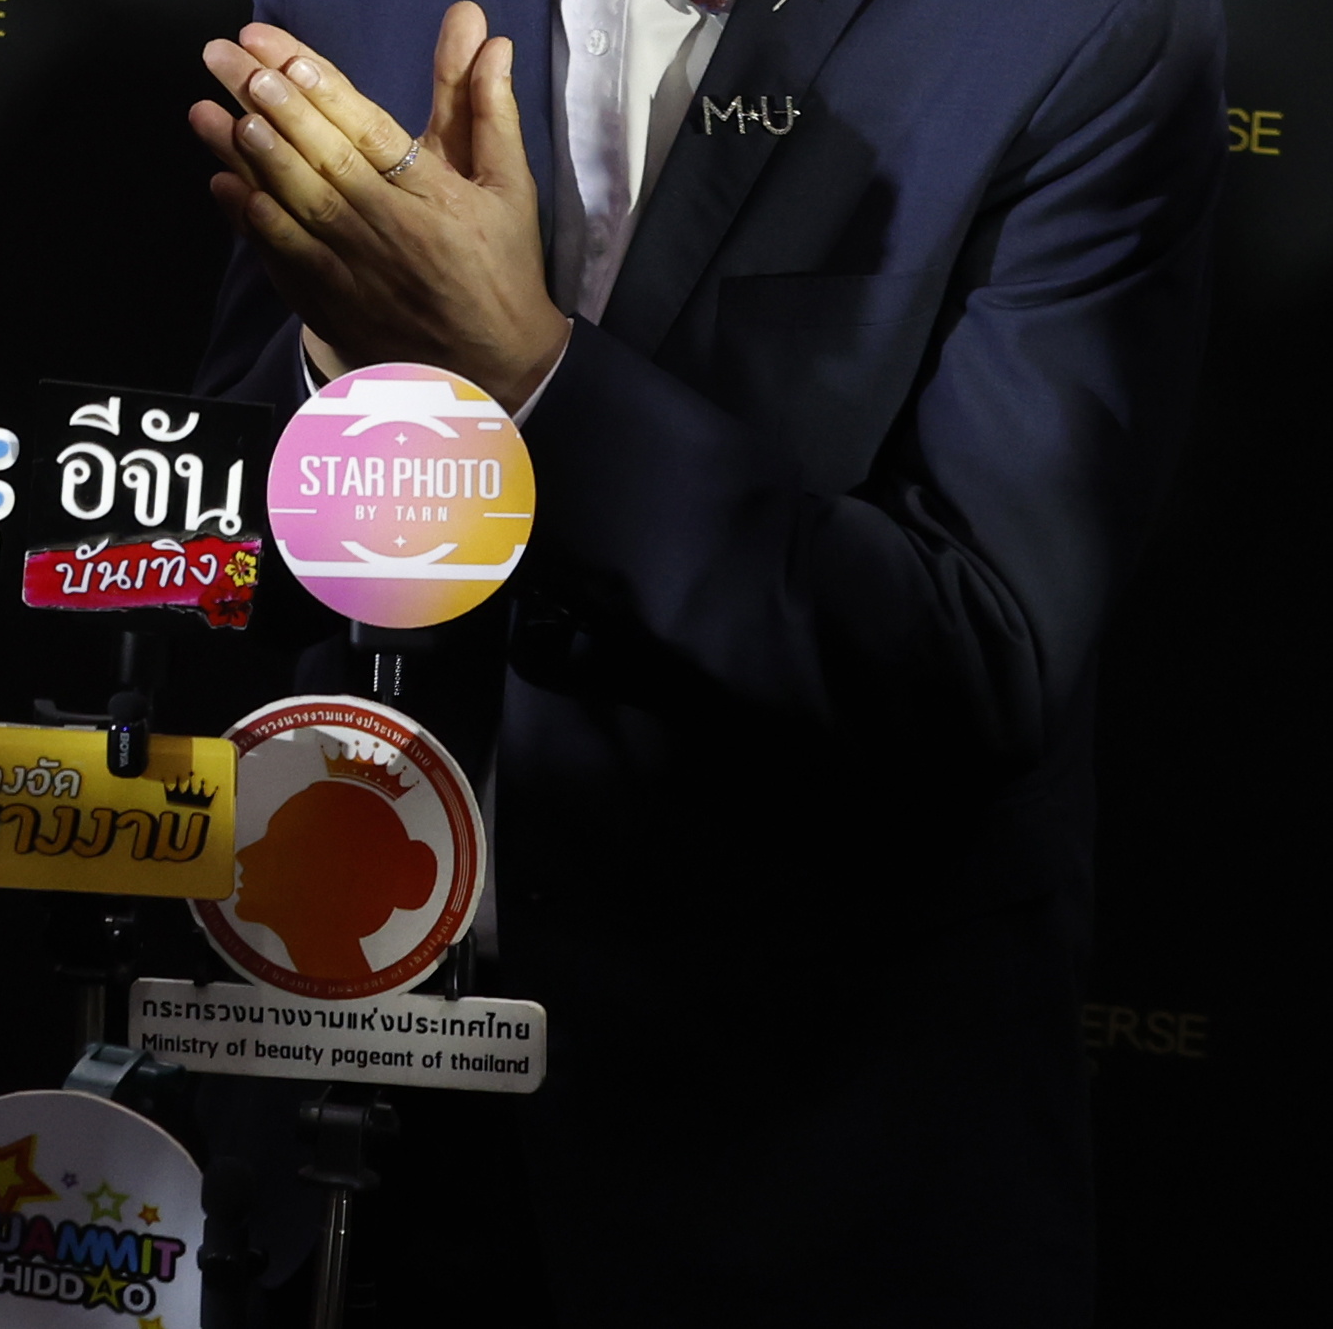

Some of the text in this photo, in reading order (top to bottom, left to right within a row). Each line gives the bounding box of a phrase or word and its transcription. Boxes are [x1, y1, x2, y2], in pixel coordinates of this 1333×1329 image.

[57, 396, 244, 535] อีจัน
[299, 455, 503, 501] STAR PHOTO
[354, 504, 450, 523] BY TARN
[55, 538, 218, 595] บันเทิง
[237, 708, 432, 768] ระทรวงนางงามแห่งประเทศไทย
[141, 997, 531, 1041] กระทรวงนางงามแห่งประเทศไทย
[141, 1033, 530, 1074] Ministry of beauty pageant of thailand
